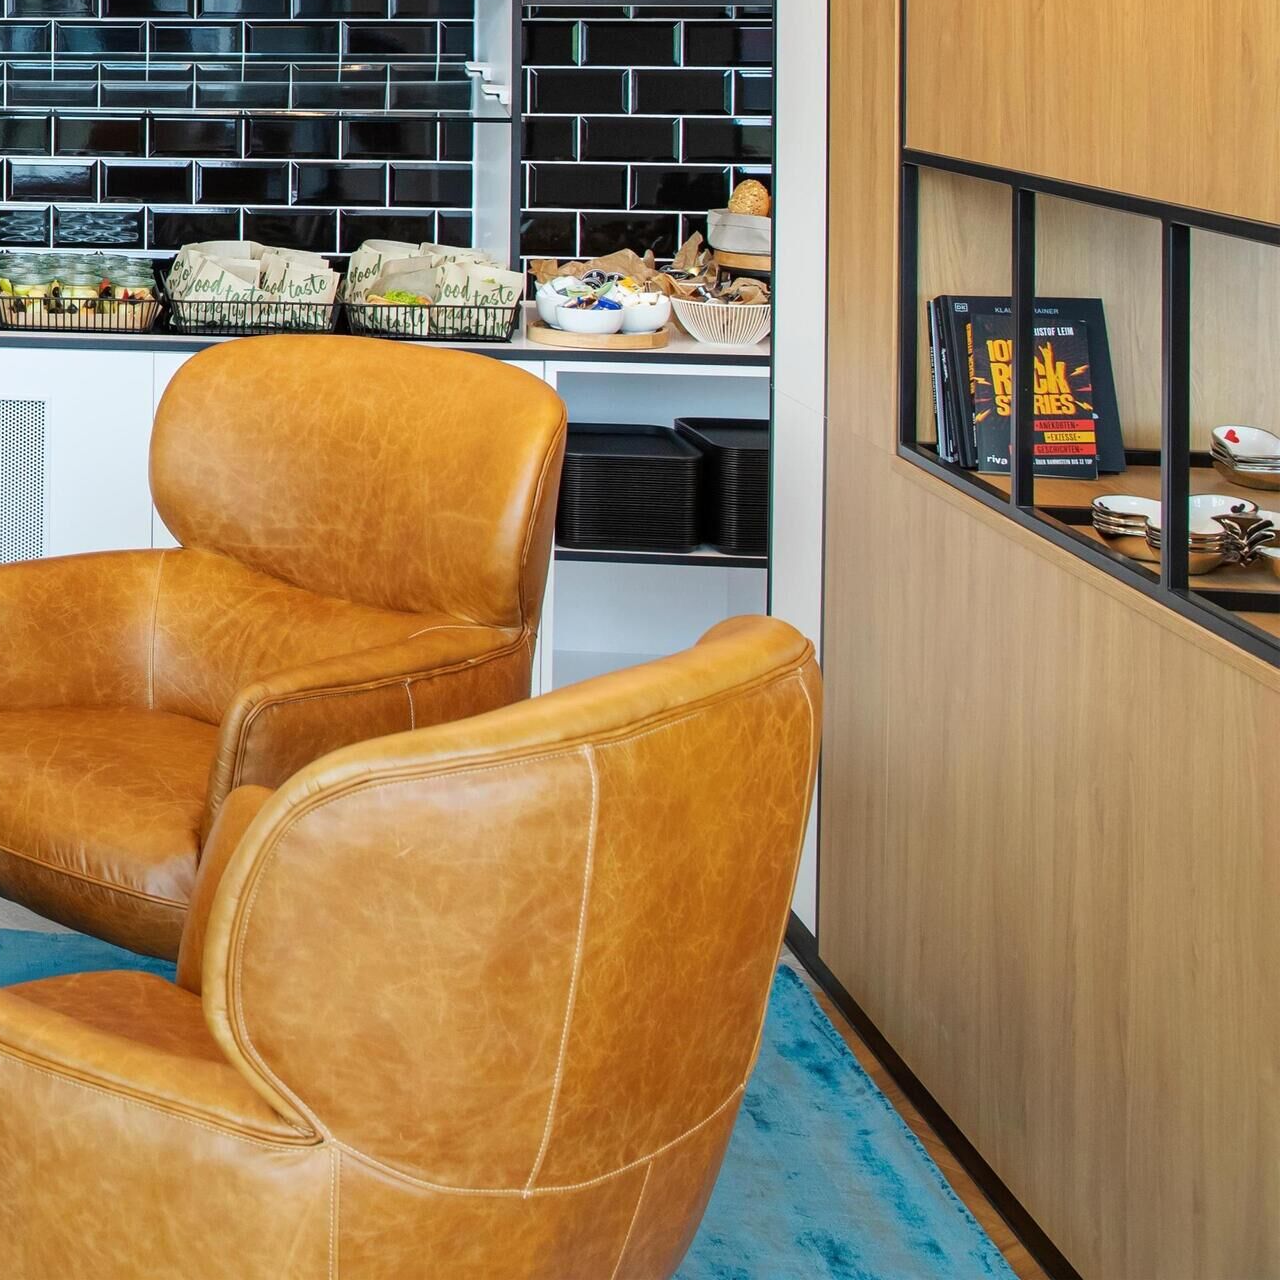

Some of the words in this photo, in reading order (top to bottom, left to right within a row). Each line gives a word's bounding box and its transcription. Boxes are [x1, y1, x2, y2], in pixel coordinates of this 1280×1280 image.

[288, 273, 328, 299] taste
[472, 284, 515, 307] taste
[990, 342, 1072, 395] RCK
[995, 394, 1077, 417] SRIES
[986, 454, 1009, 465] riva
